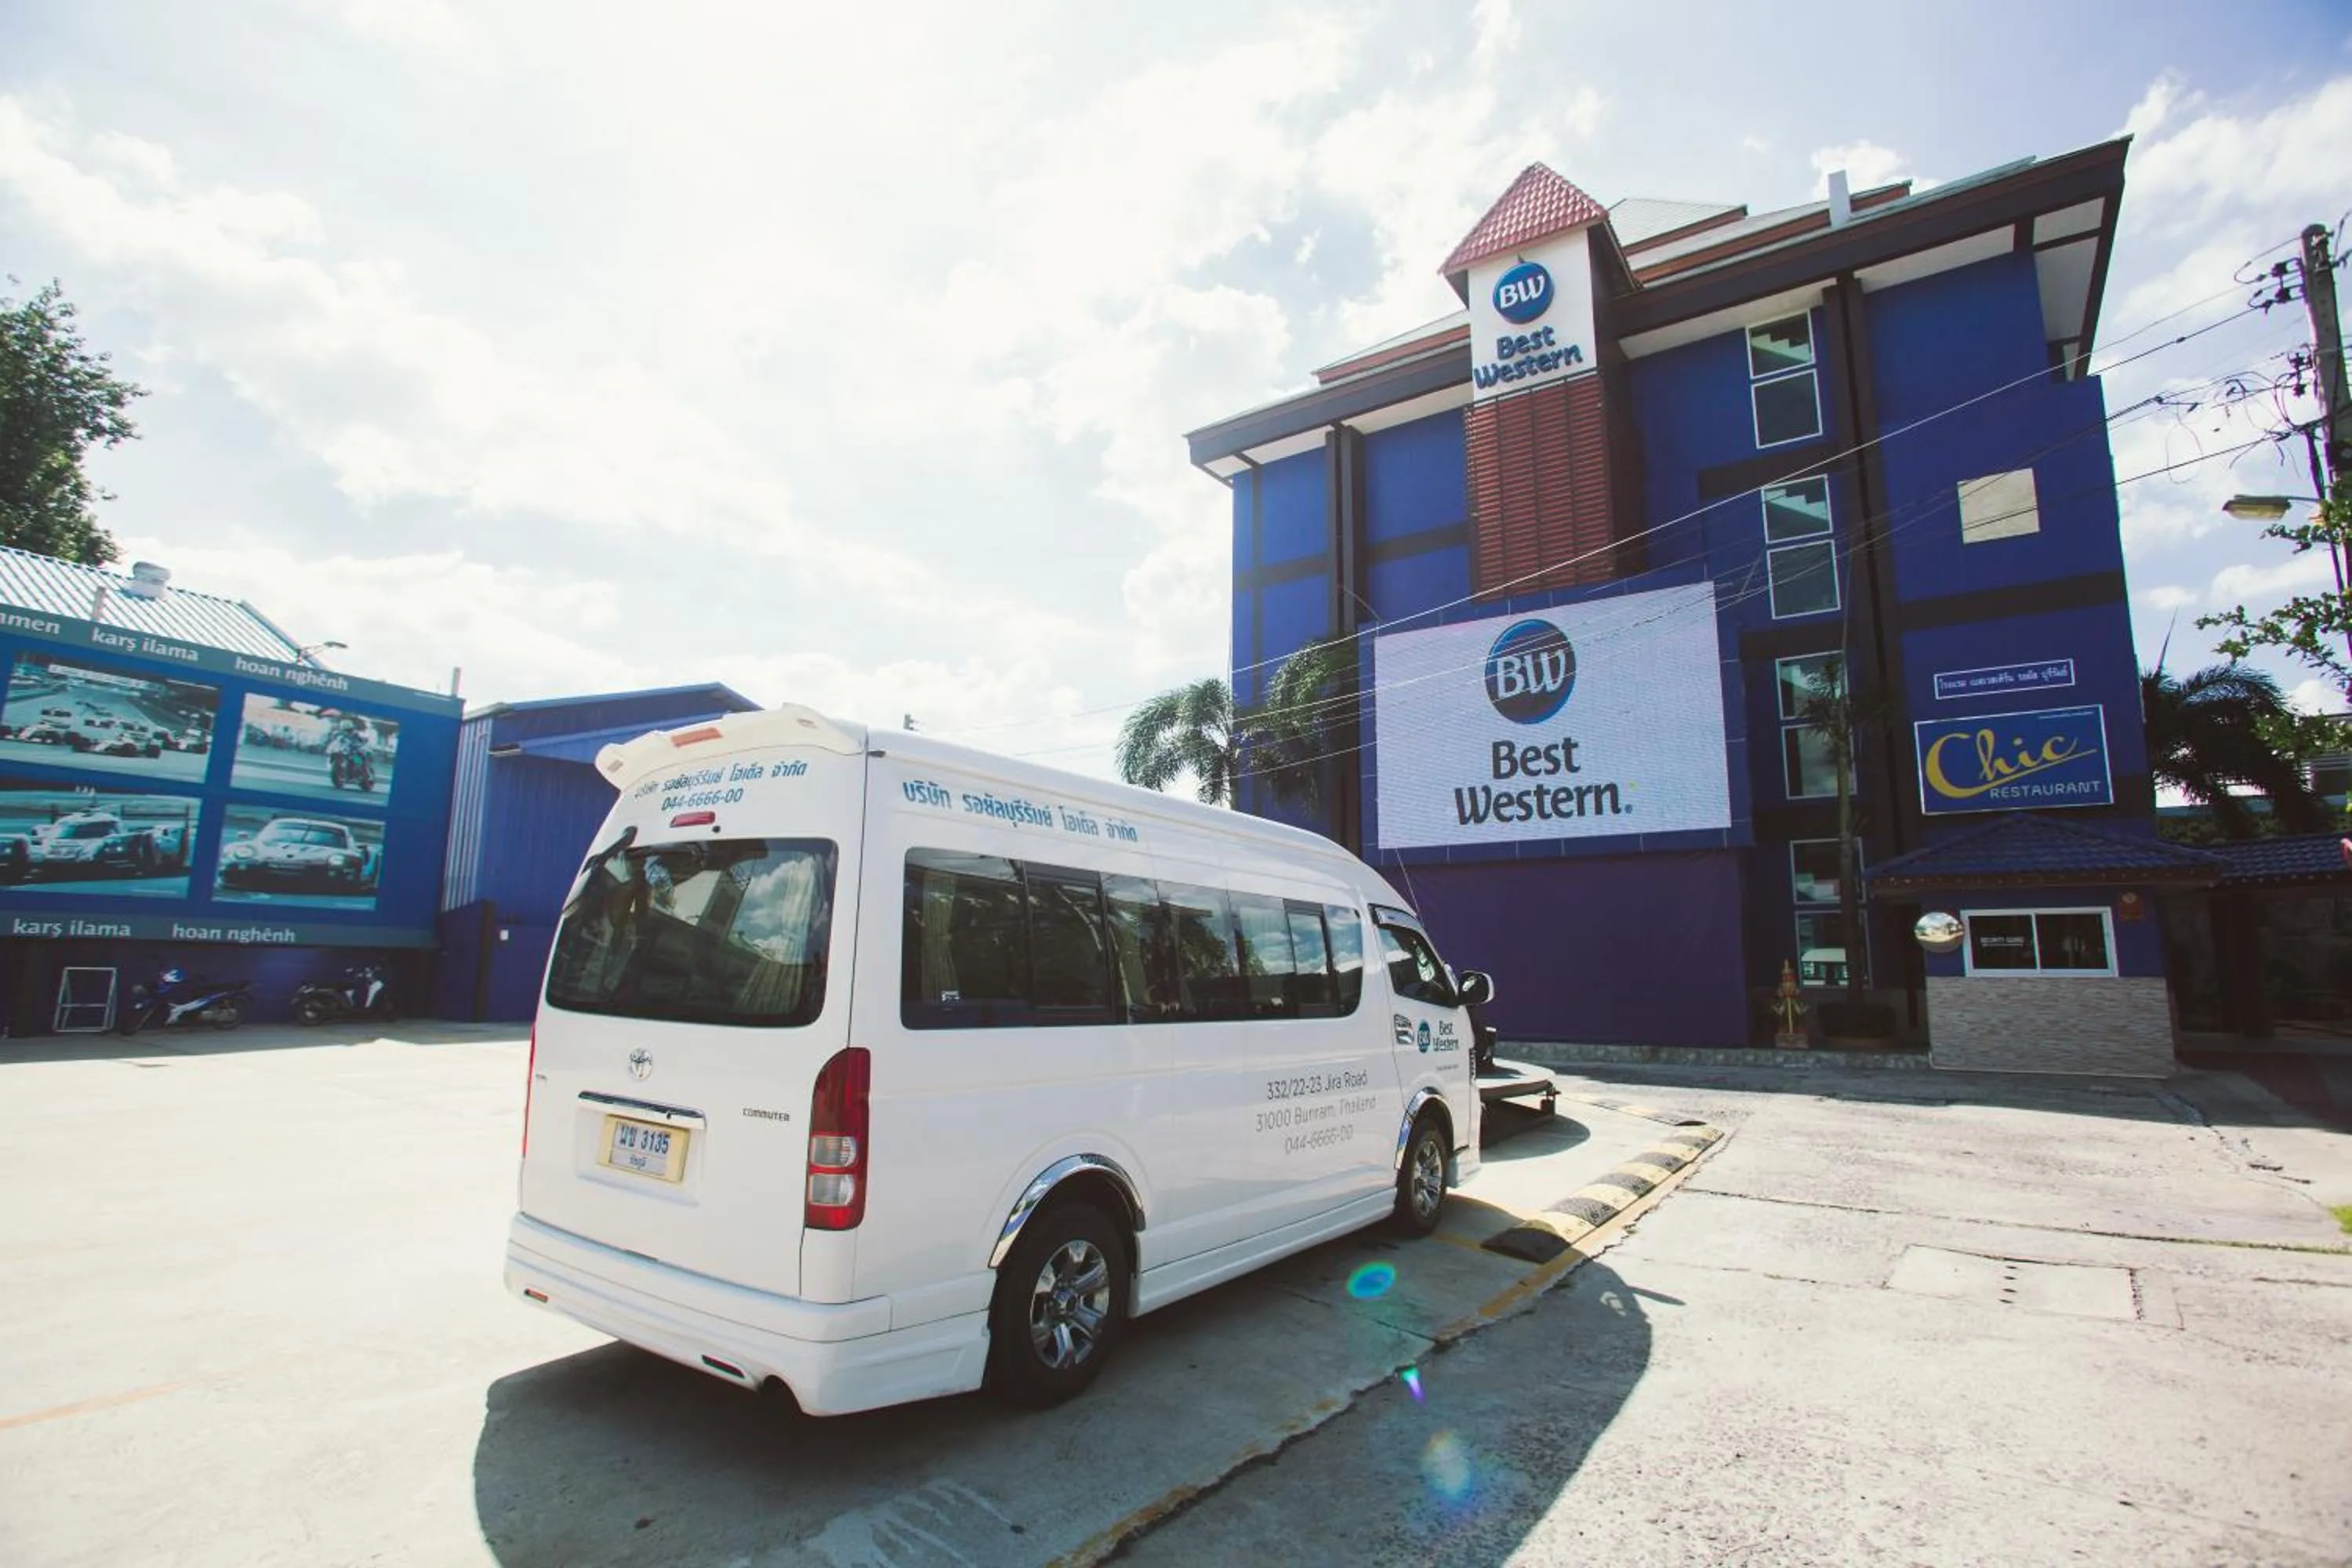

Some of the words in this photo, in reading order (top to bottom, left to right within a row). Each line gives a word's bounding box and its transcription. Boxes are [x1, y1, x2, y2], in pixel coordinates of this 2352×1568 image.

[1499, 274, 1546, 310] BW
[1497, 325, 1555, 360] Best
[1474, 344, 1584, 389] Western
[0, 612, 60, 634] men
[236, 656, 281, 677] hoan
[1496, 648, 1567, 699] BW
[1492, 737, 1581, 779] Best
[1926, 728, 2098, 798] Chic
[661, 787, 744, 811] 044-6666-00
[902, 779, 952, 810] บริษัท
[1990, 781, 2100, 799] RESTAURANT
[172, 923, 222, 941] hoan
[1266, 1075, 1323, 1100] 332/22-23
[1344, 1069, 1369, 1088] Road
[742, 1107, 790, 1122] COMMUTER
[1255, 1108, 1291, 1132] 31000
[641, 1129, 672, 1156] 3135
